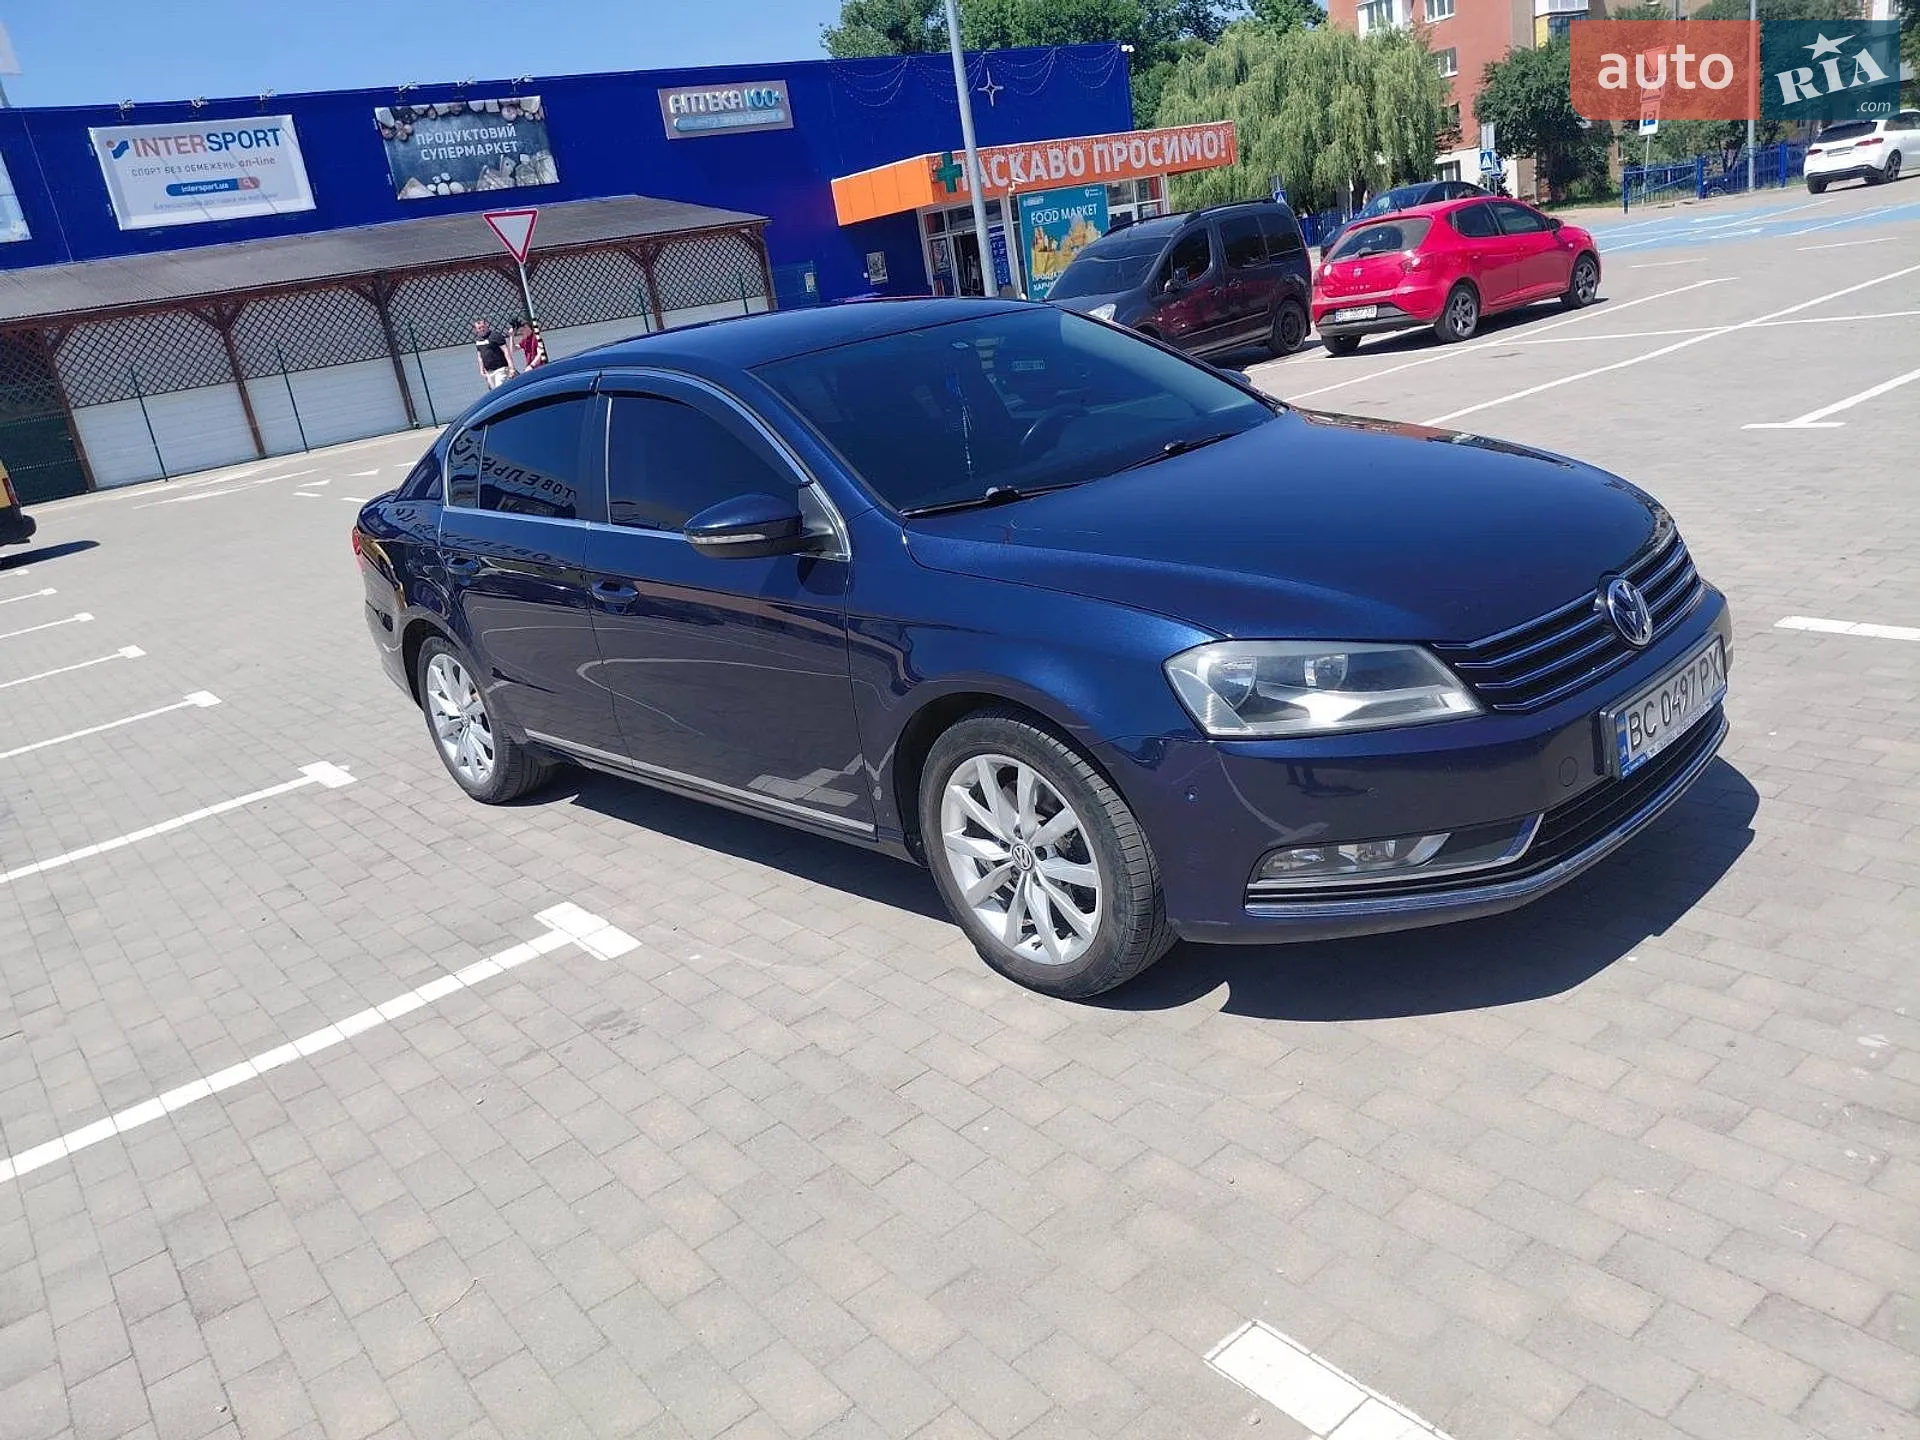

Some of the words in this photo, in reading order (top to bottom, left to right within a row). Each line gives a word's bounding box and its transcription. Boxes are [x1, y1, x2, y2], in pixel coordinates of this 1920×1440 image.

[132, 128, 281, 158] INTERSPORT
[415, 123, 517, 146] ПРОДУКТОВИЙ
[420, 141, 518, 161] СУПЕРМАРКЕТ
[1092, 130, 1226, 174] ПРОСИМО!
[1031, 210, 1060, 226] FOOD
[1060, 203, 1098, 220] MARKET
[1628, 701, 1657, 751] BC
[1660, 666, 1697, 728] 0497
